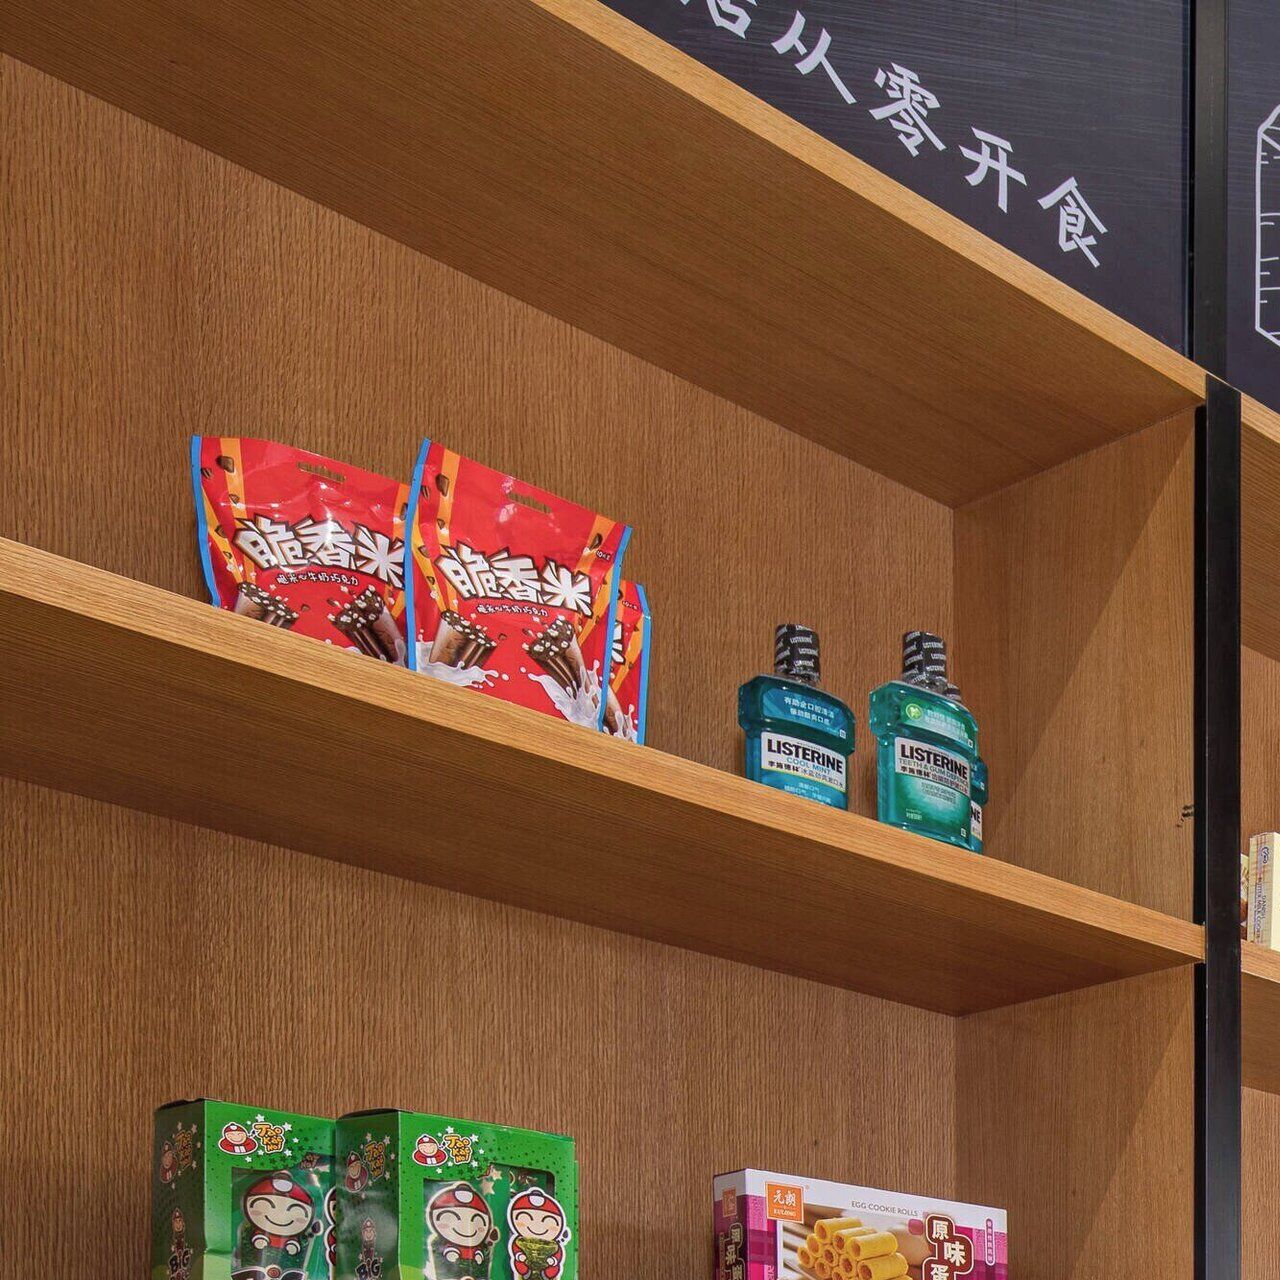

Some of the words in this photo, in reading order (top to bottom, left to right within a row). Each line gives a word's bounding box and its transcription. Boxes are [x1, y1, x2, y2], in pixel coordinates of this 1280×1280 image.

[435, 540, 593, 618] 脆香米
[767, 739, 843, 774] LISTERINE
[786, 757, 810, 769] COOL
[812, 764, 831, 775] MINT
[900, 744, 968, 780] LISTERINE
[852, 1201, 867, 1210] EGG
[868, 1203, 896, 1214] COOKIE
[897, 1208, 918, 1217] ROLLS
